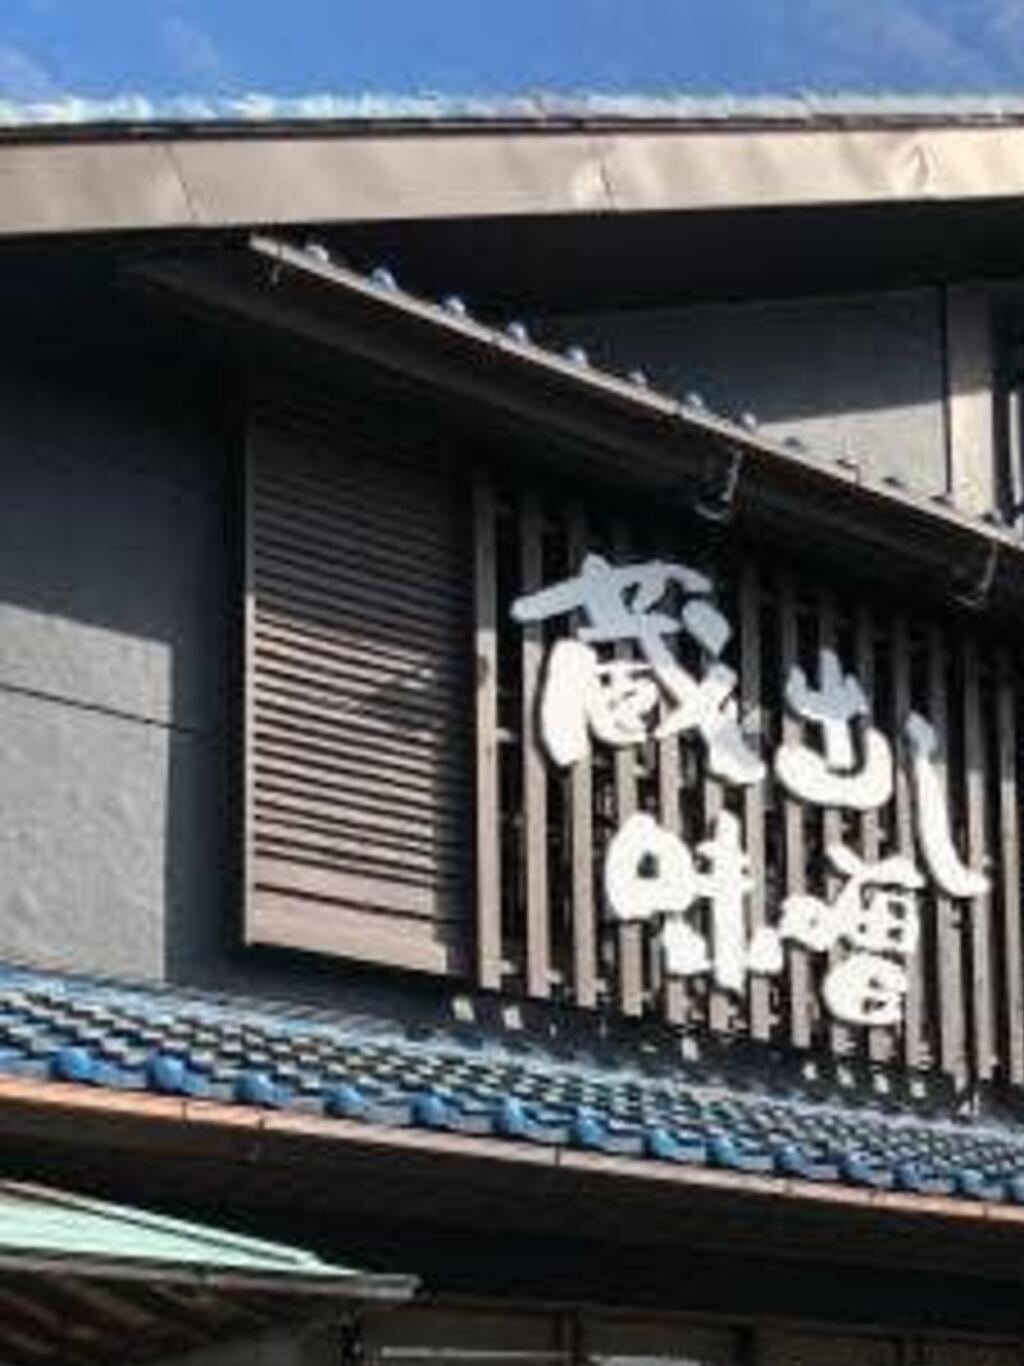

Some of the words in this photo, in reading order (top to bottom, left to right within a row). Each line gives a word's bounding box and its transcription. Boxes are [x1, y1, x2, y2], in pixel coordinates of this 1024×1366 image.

[511, 553, 992, 897] 蔵出し
[605, 808, 927, 1025] 味噌
